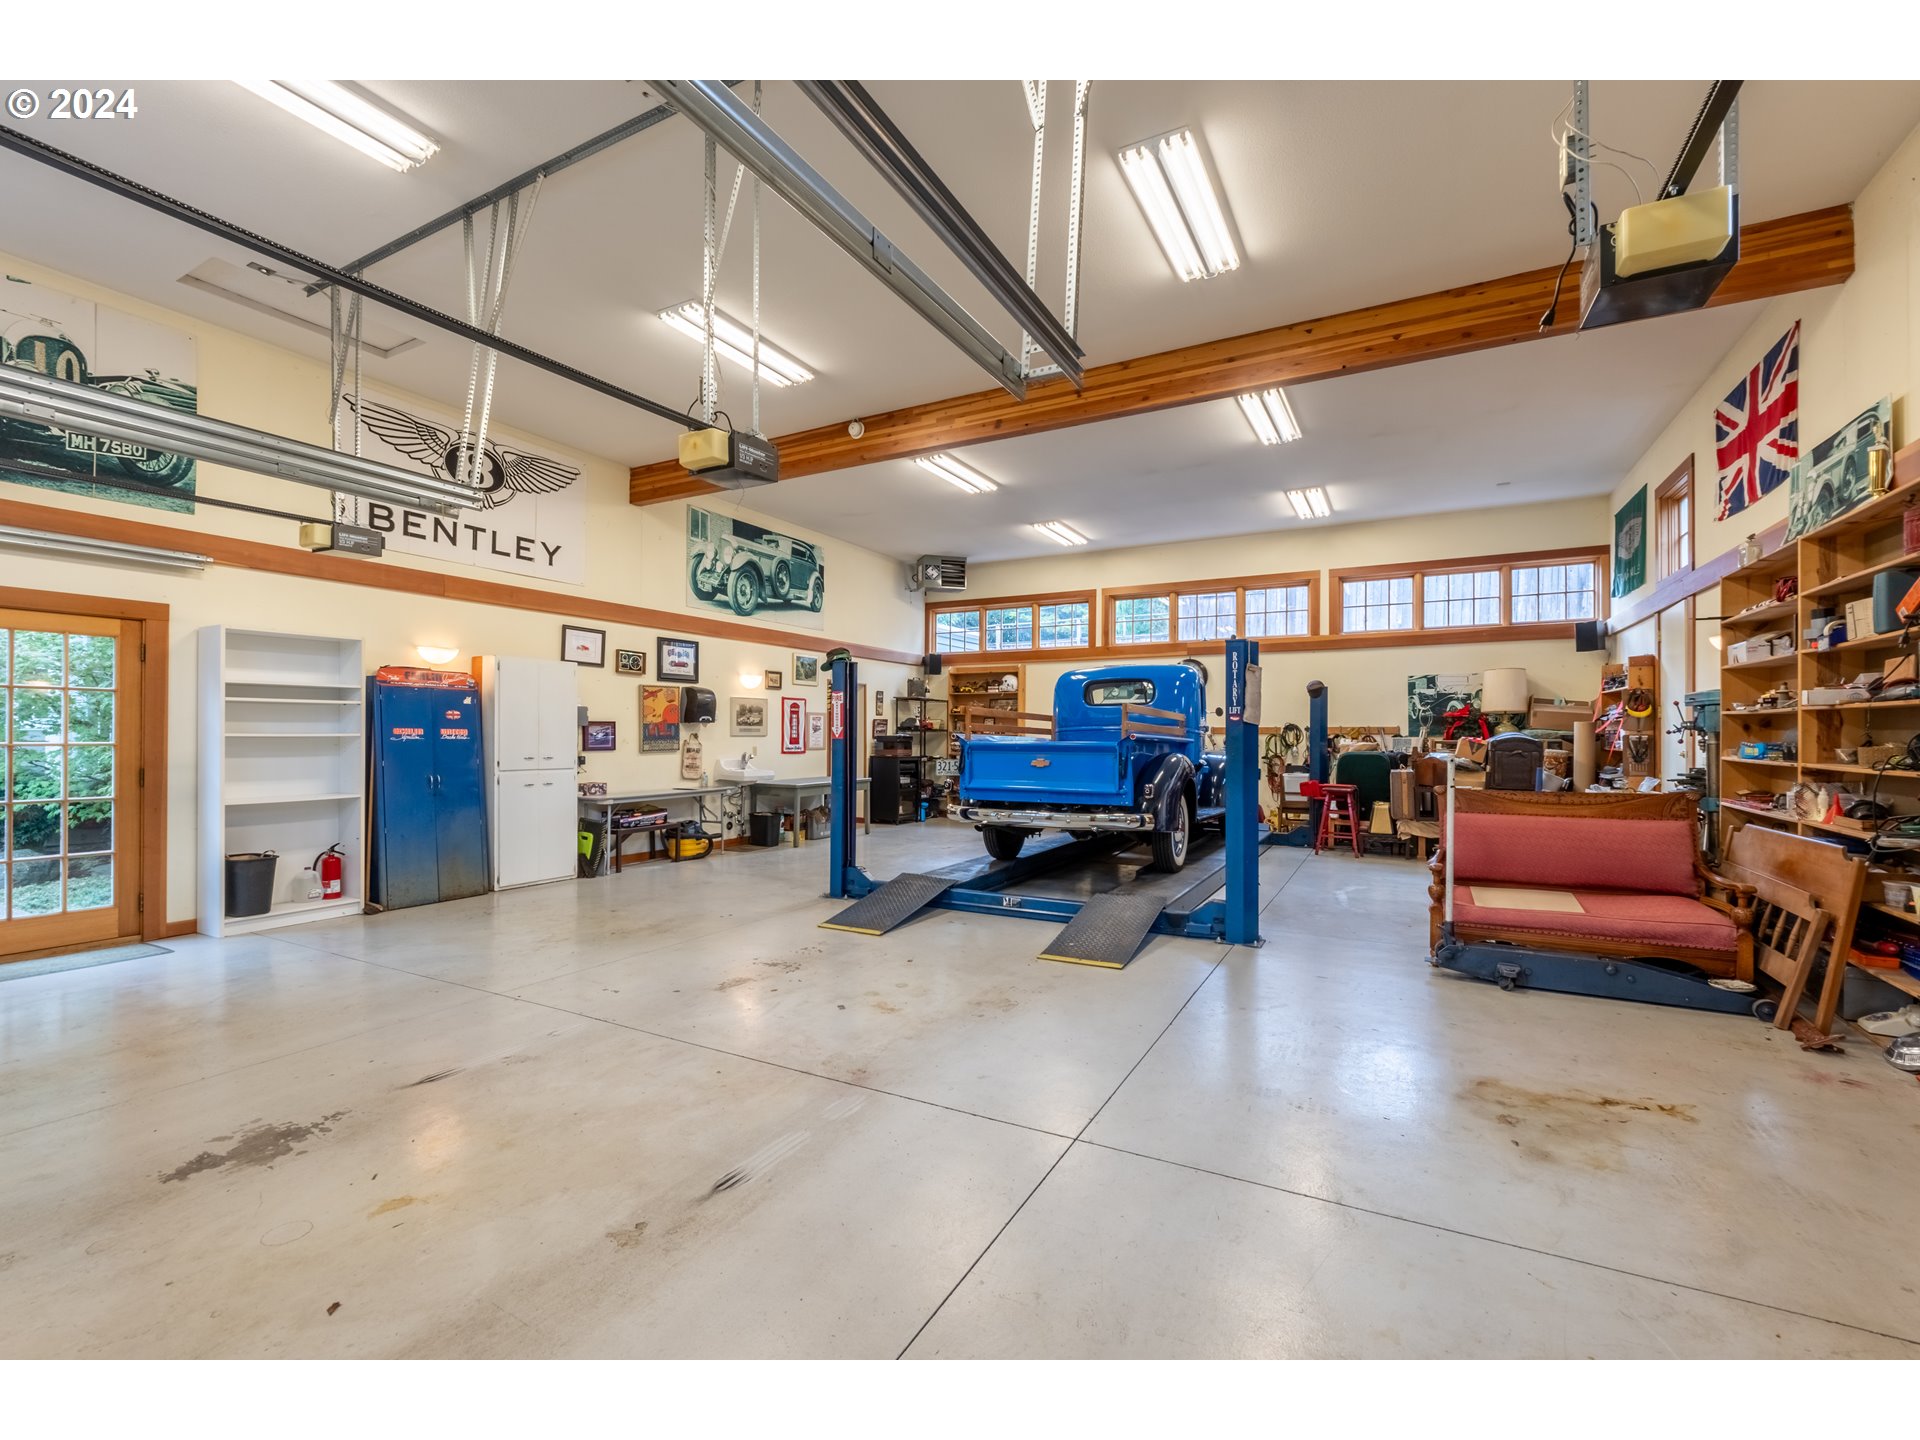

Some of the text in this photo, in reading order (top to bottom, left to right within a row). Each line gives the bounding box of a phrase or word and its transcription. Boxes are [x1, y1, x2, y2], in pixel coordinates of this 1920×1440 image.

[70, 433, 97, 450] MH
[368, 502, 562, 566] BENTLEY
[1229, 706, 1241, 714] LIFT
